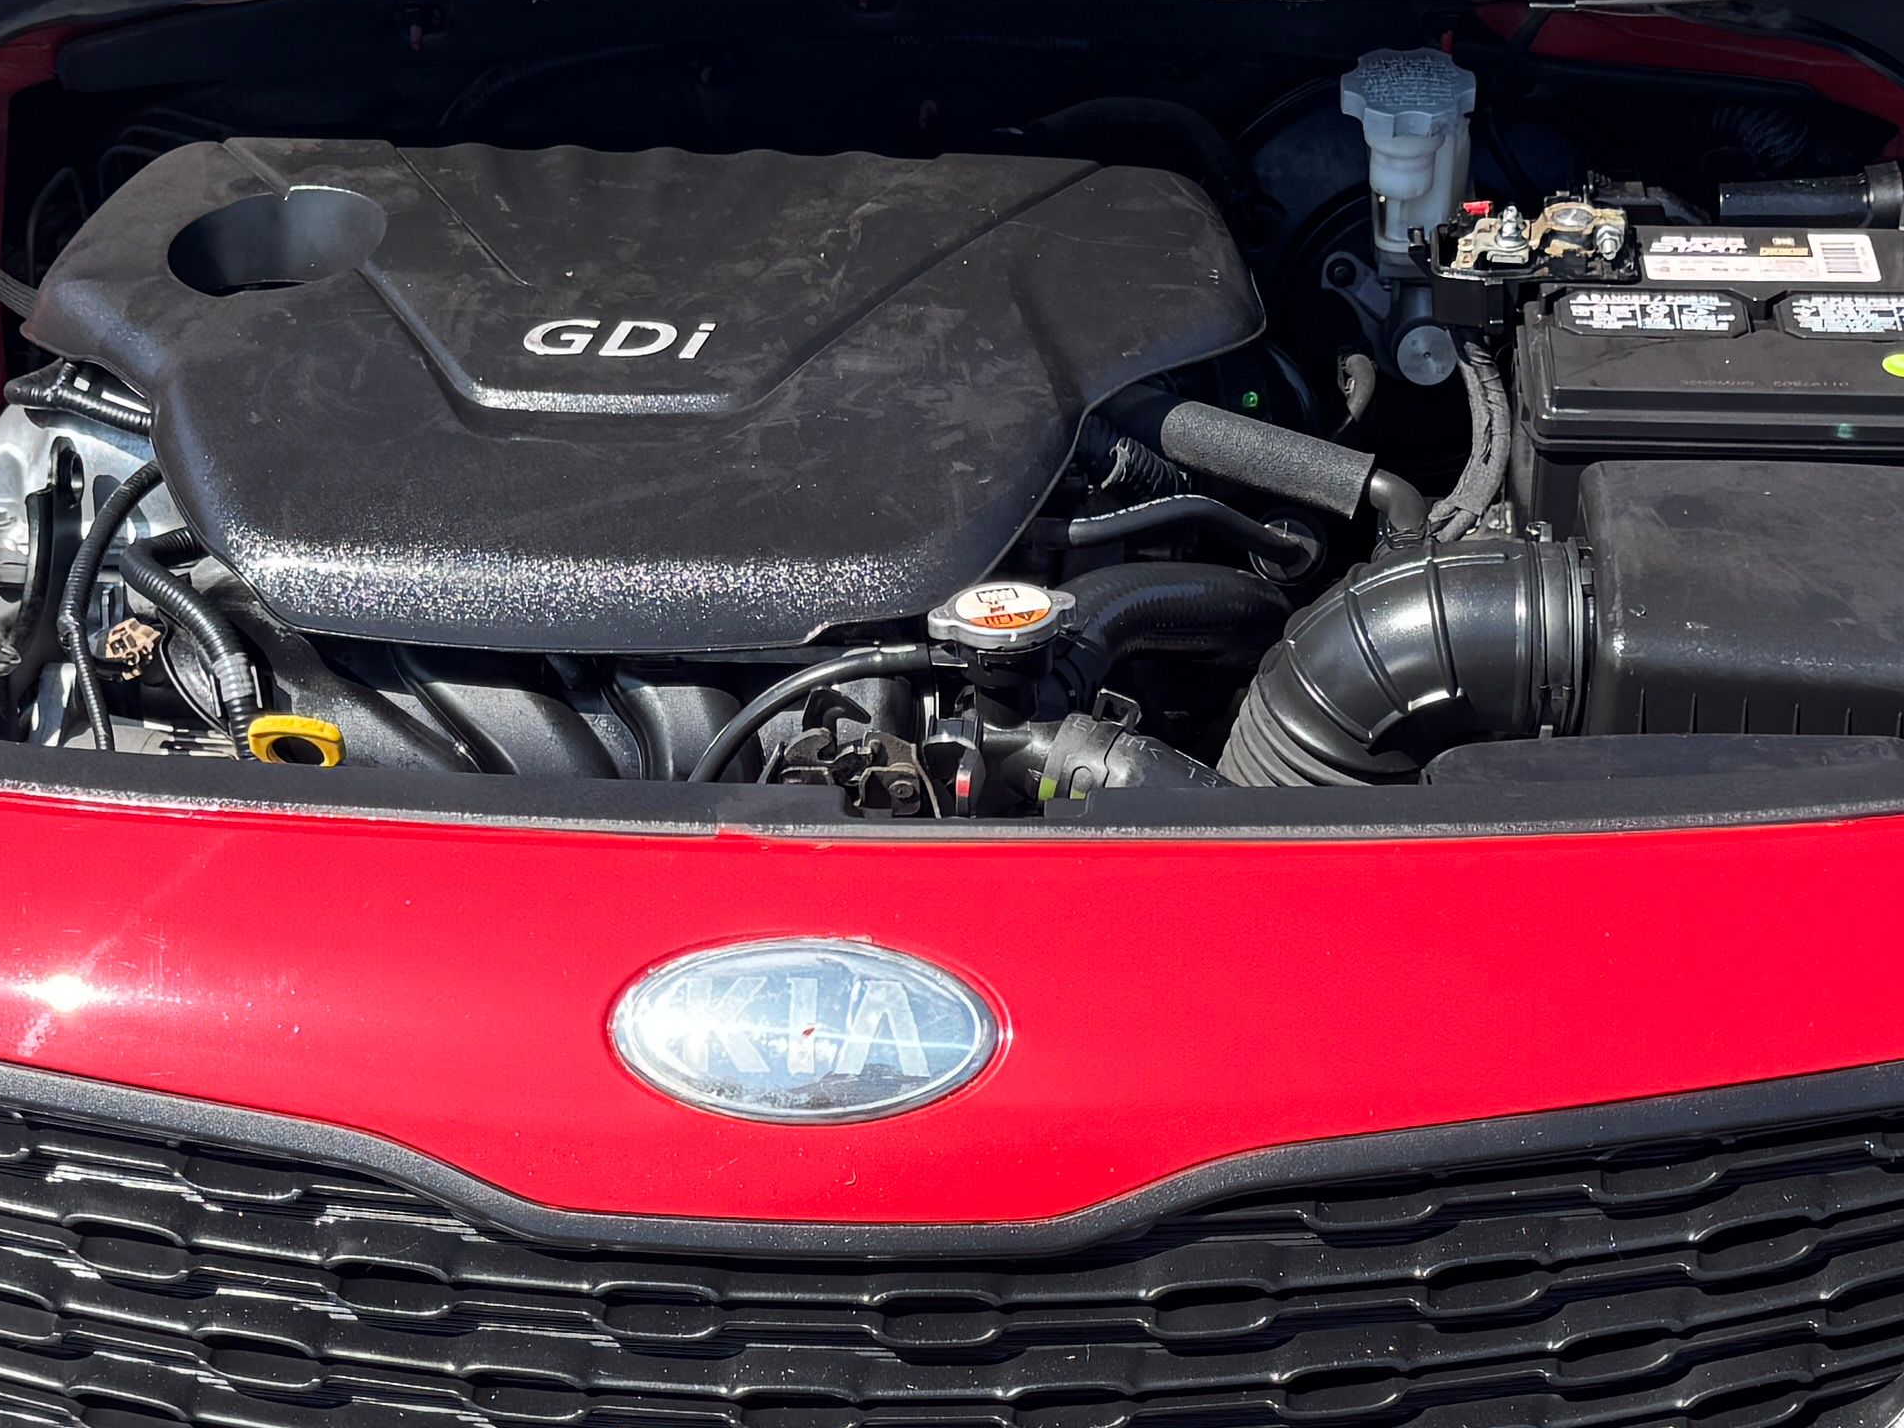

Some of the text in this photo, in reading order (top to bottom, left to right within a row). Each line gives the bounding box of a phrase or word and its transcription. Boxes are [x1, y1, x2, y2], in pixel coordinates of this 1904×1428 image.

[1590, 293, 1651, 303] DANGER
[1664, 294, 1720, 304] POISON
[523, 319, 717, 359] GDi
[684, 976, 932, 1078] KIA
